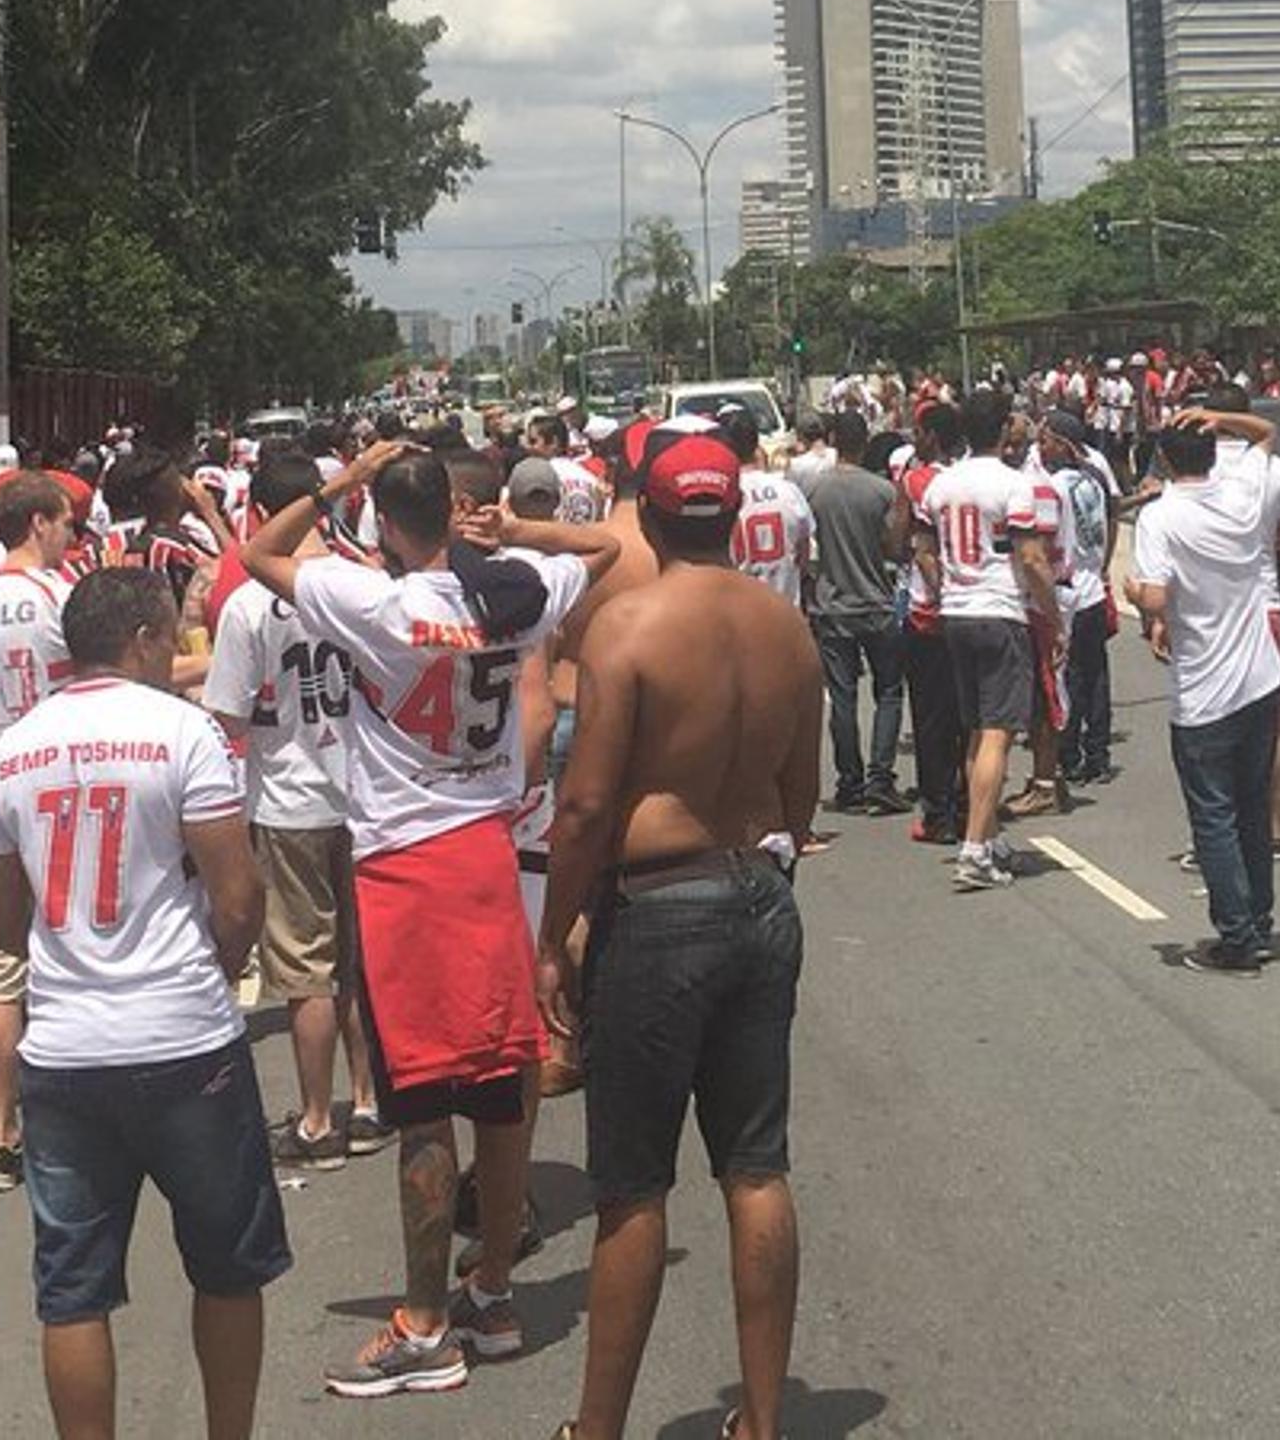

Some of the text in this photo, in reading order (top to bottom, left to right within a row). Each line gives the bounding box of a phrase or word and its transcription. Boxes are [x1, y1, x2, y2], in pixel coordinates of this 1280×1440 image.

[0, 600, 35, 625] LG
[281, 640, 351, 724] 10
[392, 648, 518, 757] 45
[0, 746, 59, 781] SEMP
[67, 741, 169, 764] TOSHIBA
[34, 784, 126, 932] 11
